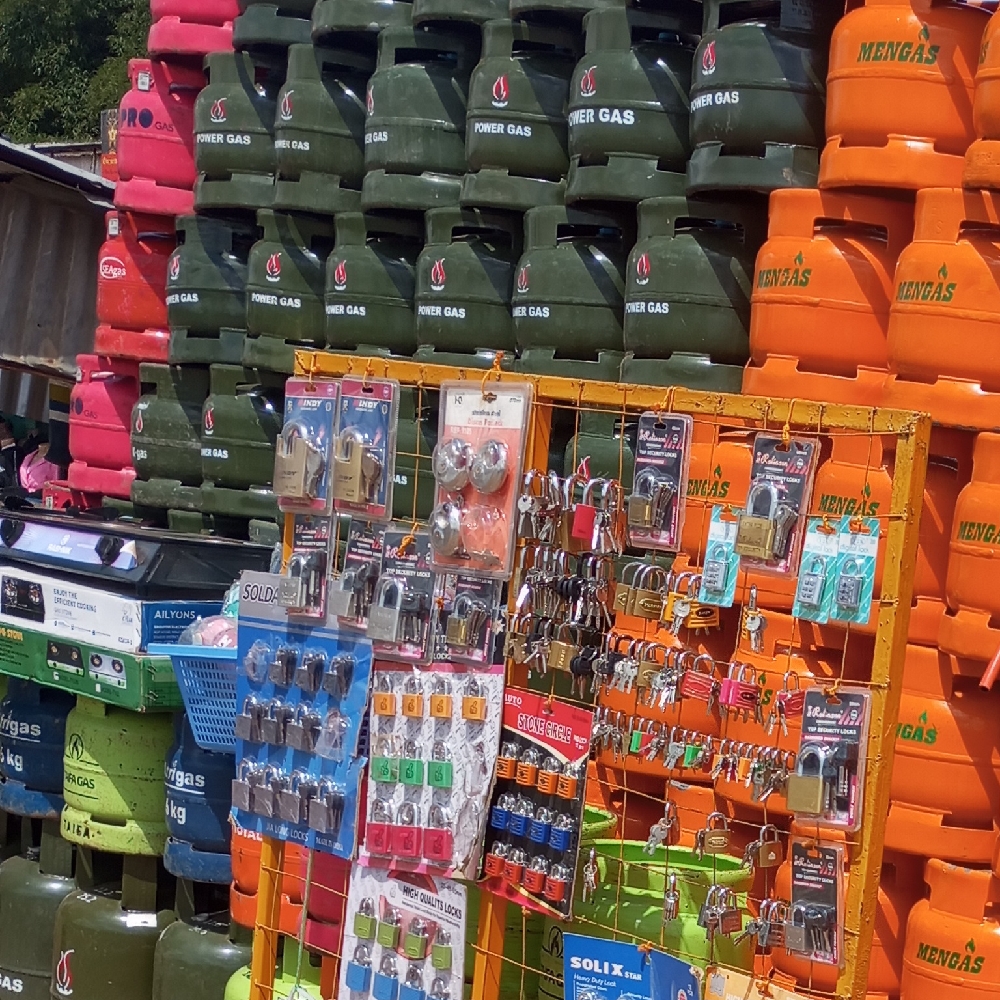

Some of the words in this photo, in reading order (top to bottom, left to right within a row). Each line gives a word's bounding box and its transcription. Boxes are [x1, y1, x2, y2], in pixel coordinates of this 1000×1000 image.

[856, 41, 941, 66] MENGAS
[690, 94, 713, 113] POWER
[715, 91, 740, 106] GAS
[122, 107, 154, 129] PRO
[154, 121, 175, 133] GAS
[567, 109, 595, 127] OWER
[598, 108, 636, 126] GAS
[196, 133, 223, 144] POWER
[226, 134, 252, 146] GAS
[373, 131, 389, 142] GAS
[474, 122, 505, 134] POWER
[507, 123, 533, 138] GAS
[757, 267, 812, 290] MENGAS
[181, 293, 200, 304] GAS
[251, 293, 278, 306] POWER
[279, 294, 302, 308] GAS
[895, 280, 957, 303] MENGAS
[346, 304, 366, 317] GAS
[418, 305, 442, 316] POWER
[443, 306, 466, 319] GAS
[528, 306, 550, 319] GAS
[626, 302, 645, 315] POWER
[648, 302, 670, 315] GAS
[212, 449, 229, 460] GAS
[686, 478, 731, 498] ENGAS
[154, 610, 196, 619] AILYONS
[517, 713, 546, 737] STONE
[545, 720, 573, 745] CIRCLE
[6, 749, 24, 772] kg
[171, 800, 187, 825] kg
[290, 829, 309, 842] LOCKS
[402, 885, 418, 899] HIGH
[444, 901, 463, 920] LOCKS
[916, 941, 985, 975] MENGAS
[570, 956, 624, 978] SOLIX
[624, 970, 643, 981] STAR
[0, 973, 24, 993] AS
[591, 976, 604, 986] Duty
